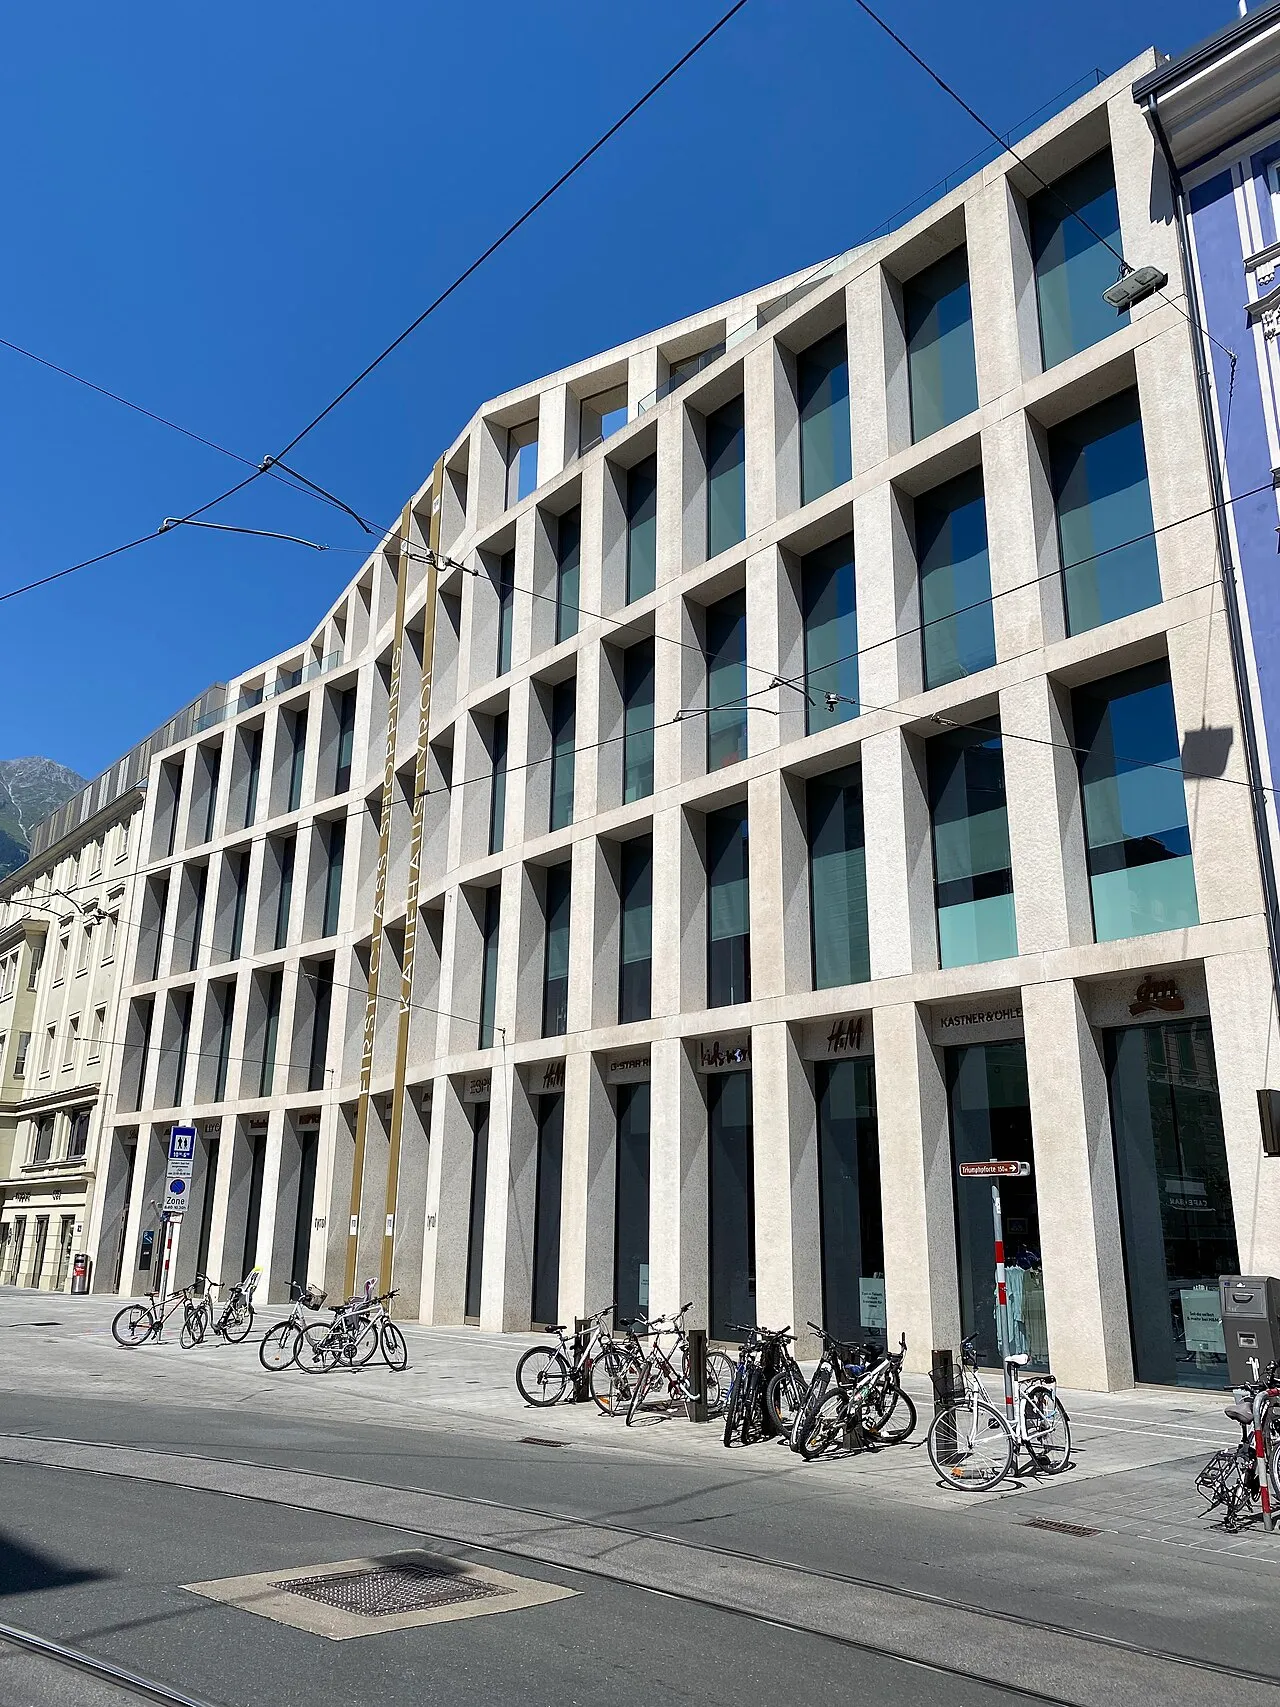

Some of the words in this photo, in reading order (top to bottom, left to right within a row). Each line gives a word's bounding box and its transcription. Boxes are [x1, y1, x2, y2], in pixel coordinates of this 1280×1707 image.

[380, 647, 401, 837] SHOPPING
[827, 1016, 864, 1052] H&M
[961, 1166, 996, 1174] Triumphpforte
[166, 1196, 185, 1205] Zone
